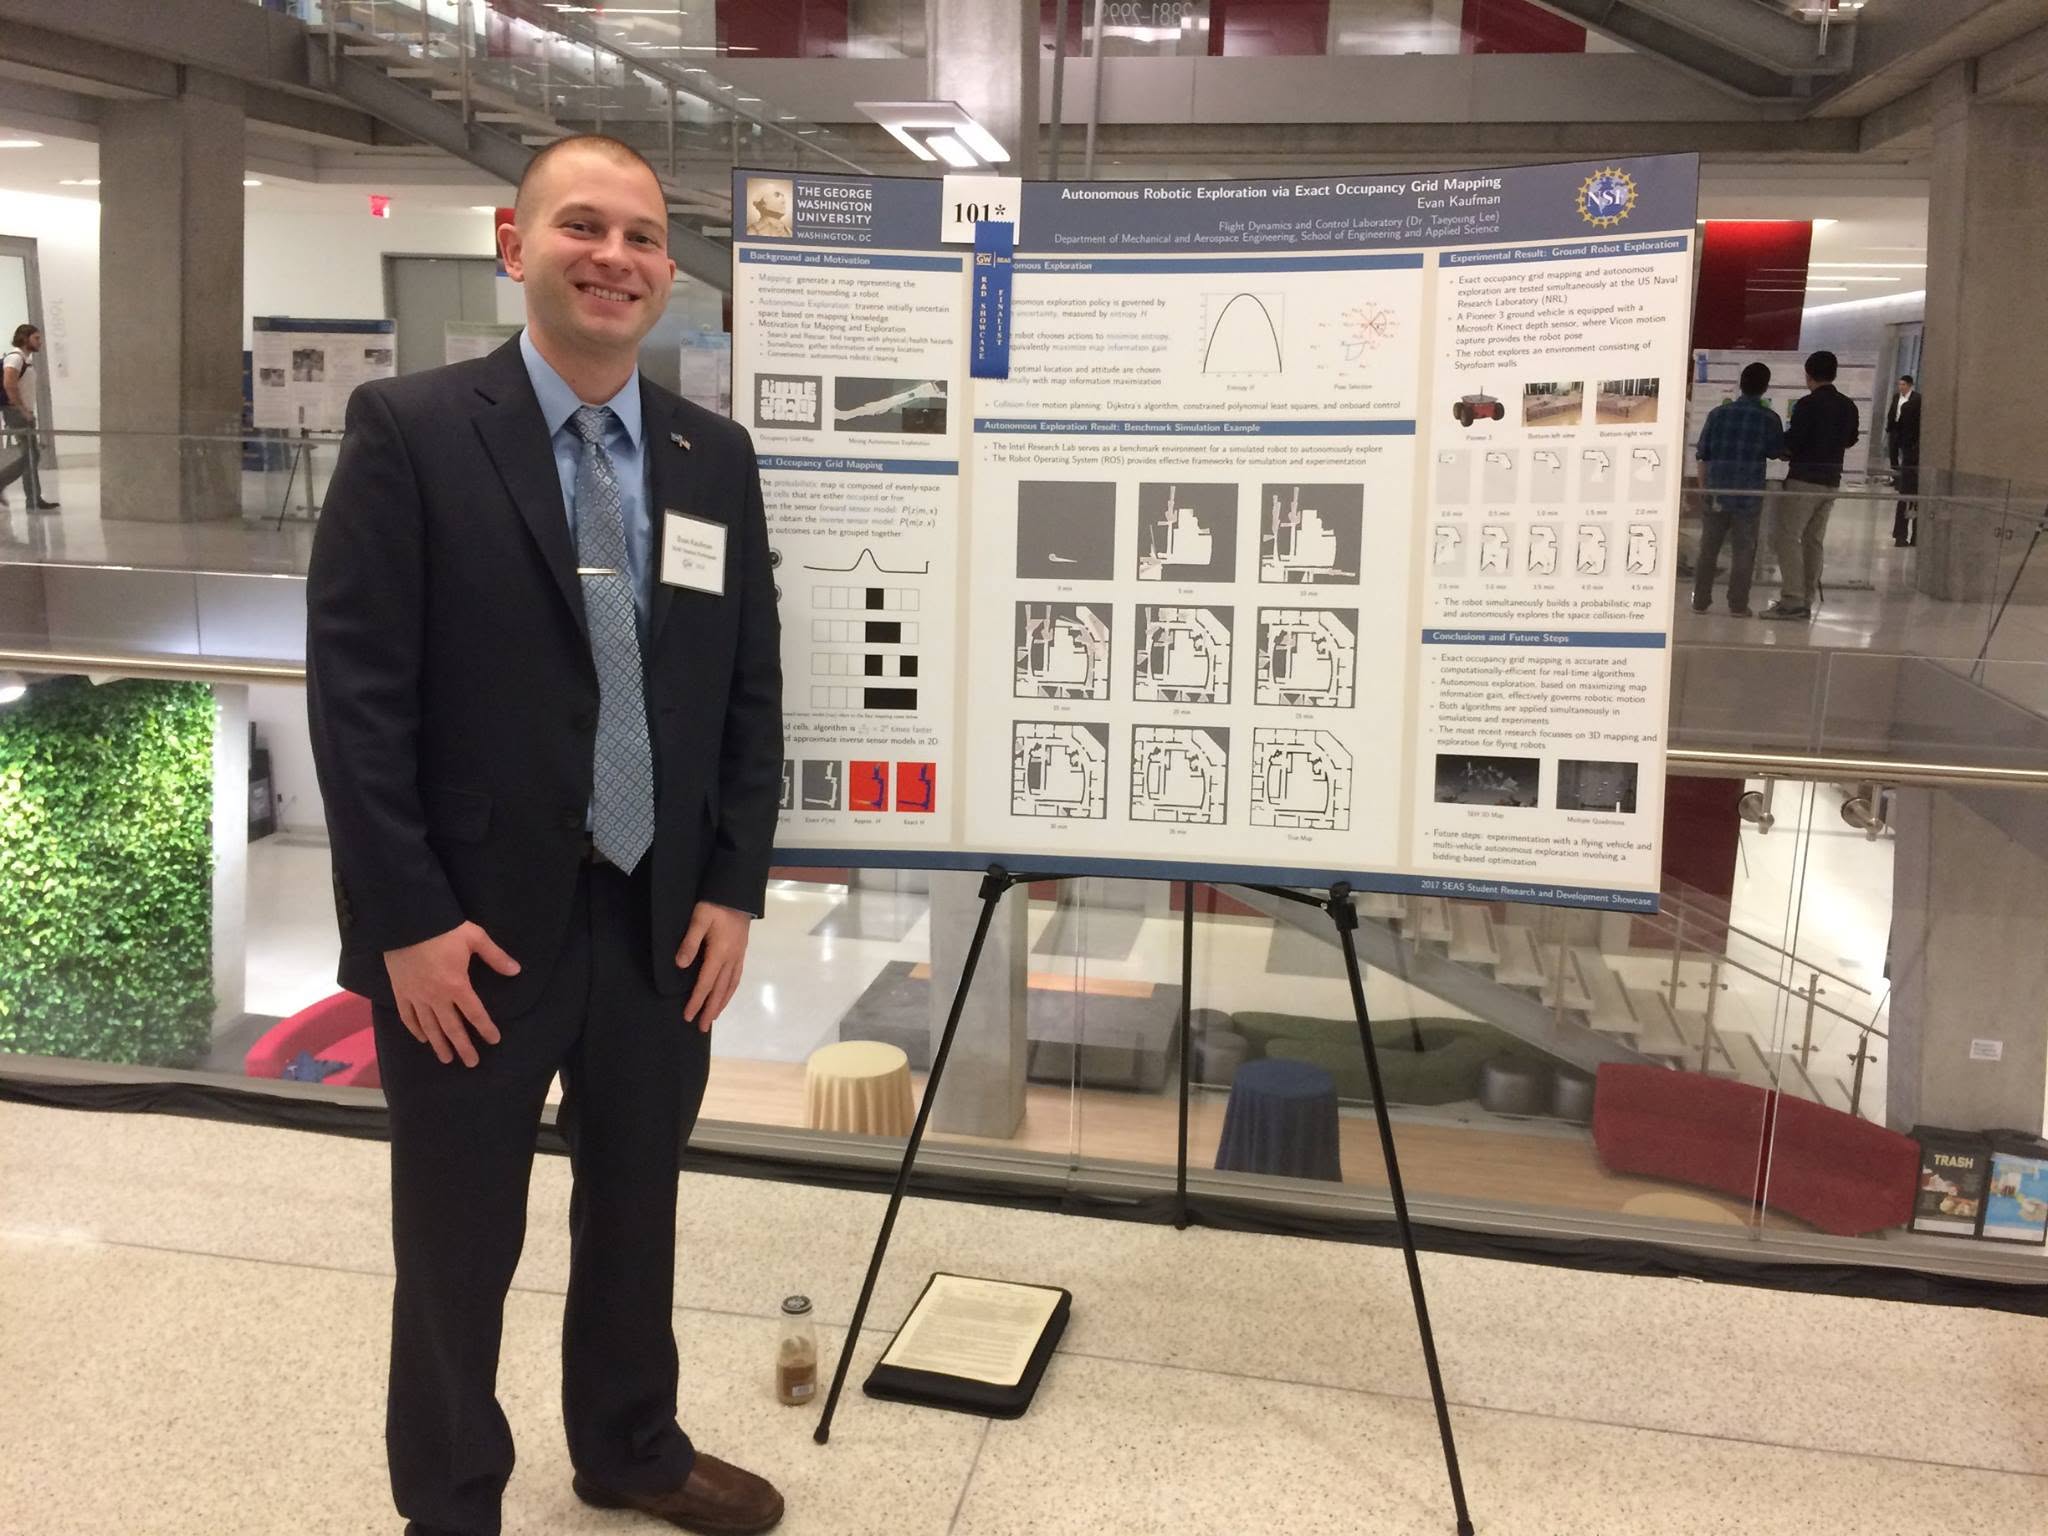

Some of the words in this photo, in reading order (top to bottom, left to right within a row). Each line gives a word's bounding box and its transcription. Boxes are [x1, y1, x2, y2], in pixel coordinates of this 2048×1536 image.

[798, 185, 820, 196] THE
[822, 187, 872, 199] GEORGE
[1061, 188, 1139, 200] Autonomous
[1143, 187, 1191, 199] Robotic
[1196, 186, 1266, 198] Exploration
[1271, 188, 1289, 196] via
[1294, 184, 1330, 196] Exact
[1335, 181, 1406, 197] Occupancy
[1410, 179, 1438, 192] Grid
[1443, 176, 1501, 191] Mapping
[797, 199, 872, 211] WASHINGTON
[1416, 196, 1444, 208] Evan
[1448, 193, 1500, 206] Kaufman
[796, 212, 871, 224] UNIVERSITY
[1218, 220, 1244, 233] Flight
[1247, 220, 1292, 230] Dynamics
[1294, 219, 1312, 229] and
[1314, 218, 1353, 229] Control
[1352, 216, 1403, 228] Laboratory
[1431, 213, 1475, 226] Taeyoung
[1478, 211, 1500, 223] Lee)
[858, 233, 871, 242] DC
[1054, 233, 1106, 243] Department
[1108, 233, 1118, 243] of
[1121, 233, 1171, 243] Mechanical
[1174, 233, 1190, 243] and
[1193, 233, 1239, 243] Aerospace
[1242, 231, 1297, 243] Engineering,
[1300, 229, 1332, 240] School
[1334, 229, 1344, 239] of
[1347, 230, 1401, 241] Engineering
[1404, 227, 1422, 237] and
[1424, 225, 1460, 238] Applied
[1463, 222, 1499, 234] Science
[749, 251, 801, 263] Background
[804, 253, 820, 262] and
[822, 254, 870, 265] Motivation
[1449, 250, 1511, 263] Experimental
[1513, 248, 1546, 259] Result:
[1551, 245, 1587, 256] Ground
[1590, 243, 1620, 254] Robot
[1623, 239, 1679, 251] Exploration
[1044, 261, 1092, 270] Exploration
[1458, 274, 1480, 284] Exact
[1482, 274, 1526, 283] occupancy
[1527, 271, 1544, 282] grid
[1546, 270, 1582, 280] mapping
[1584, 267, 1600, 276] and
[1602, 265, 1654, 275] autonomous
[1457, 287, 1501, 296] exploration
[1518, 284, 1544, 293] tested
[1546, 280, 1607, 291] simultaneously
[1620, 278, 1634, 286] the
[1637, 276, 1650, 286] US
[1653, 274, 1678, 284] Naval
[1456, 298, 1492, 308] Research
[1494, 297, 1538, 306] Laboratory
[1540, 293, 1567, 305] (NRL)
[996, 290, 1004, 346] FINALIST
[1456, 312, 1463, 320] A
[1465, 310, 1496, 320] Pioneer
[1498, 310, 1504, 319] 3
[1506, 310, 1535, 320] ground
[1536, 307, 1565, 317] vehicle
[1576, 304, 1614, 316] equipped
[1616, 303, 1635, 312] with
[757, 319, 798, 328] Motivation
[800, 320, 811, 329] for
[813, 321, 846, 332] Mapping
[848, 323, 862, 331] and
[864, 323, 906, 333] Exploration
[1456, 322, 1493, 333] Microsoft
[1496, 321, 1522, 331] Kinect
[1524, 320, 1548, 330] depth
[1581, 317, 1606, 326] where
[1609, 316, 1633, 325] Vicon
[1635, 315, 1666, 323] motion
[978, 303, 987, 360] SHOWCASE
[1455, 337, 1485, 345] capture
[1487, 334, 1520, 344] provides
[1522, 333, 1536, 342] the
[1538, 332, 1561, 341] robot
[1563, 332, 1583, 340] pose
[1456, 348, 1471, 357] The
[1472, 348, 1495, 357] robot
[1496, 348, 1530, 356] explores
[1598, 342, 1640, 352] consisting
[1641, 340, 1651, 349] of
[1454, 359, 1495, 370] Styrofoam
[1497, 359, 1517, 368] walls
[984, 421, 1037, 429] Autonomous
[1039, 421, 1087, 430] Exploration
[1123, 422, 1171, 431] Benchmark
[1174, 423, 1220, 431] Simulation
[1223, 423, 1260, 432] Example
[775, 459, 822, 467] Occupancy
[824, 459, 843, 467] Grid
[846, 460, 883, 471] Mapping
[992, 453, 1006, 462] The
[1008, 454, 1030, 462] Robot
[1032, 454, 1069, 464] Operating
[1071, 455, 1098, 464] System
[1100, 455, 1124, 465] (ROS)
[1126, 456, 1156, 464] provides
[1158, 456, 1190, 464] effective
[1235, 456, 1246, 464] for
[1289, 457, 1303, 465] and
[1444, 596, 1459, 606] The
[1461, 598, 1482, 606] robot
[1485, 598, 1543, 606] simultaneously
[1545, 598, 1570, 607] builds
[1580, 599, 1629, 608] probabilistic
[1432, 631, 1486, 641] Conclusions
[1488, 632, 1506, 641] and
[1508, 632, 1539, 642] Future
[1542, 633, 1569, 643] Steps
[1436, 738, 1480, 746] exploration
[1482, 738, 1493, 747] for
[1495, 738, 1518, 749] flying
[1519, 740, 1546, 749] robots
[1432, 852, 1485, 864] bidding-based
[1487, 857, 1537, 866] optimization
[1420, 879, 1440, 889] 2017
[1441, 880, 1465, 891] SEAS
[1466, 882, 1498, 894] Student
[1500, 885, 1536, 896] Research
[1537, 888, 1553, 897] and
[1555, 889, 1609, 902] Development
[1611, 894, 1652, 905] Showcase
[1934, 1154, 1974, 1169] TRASH
